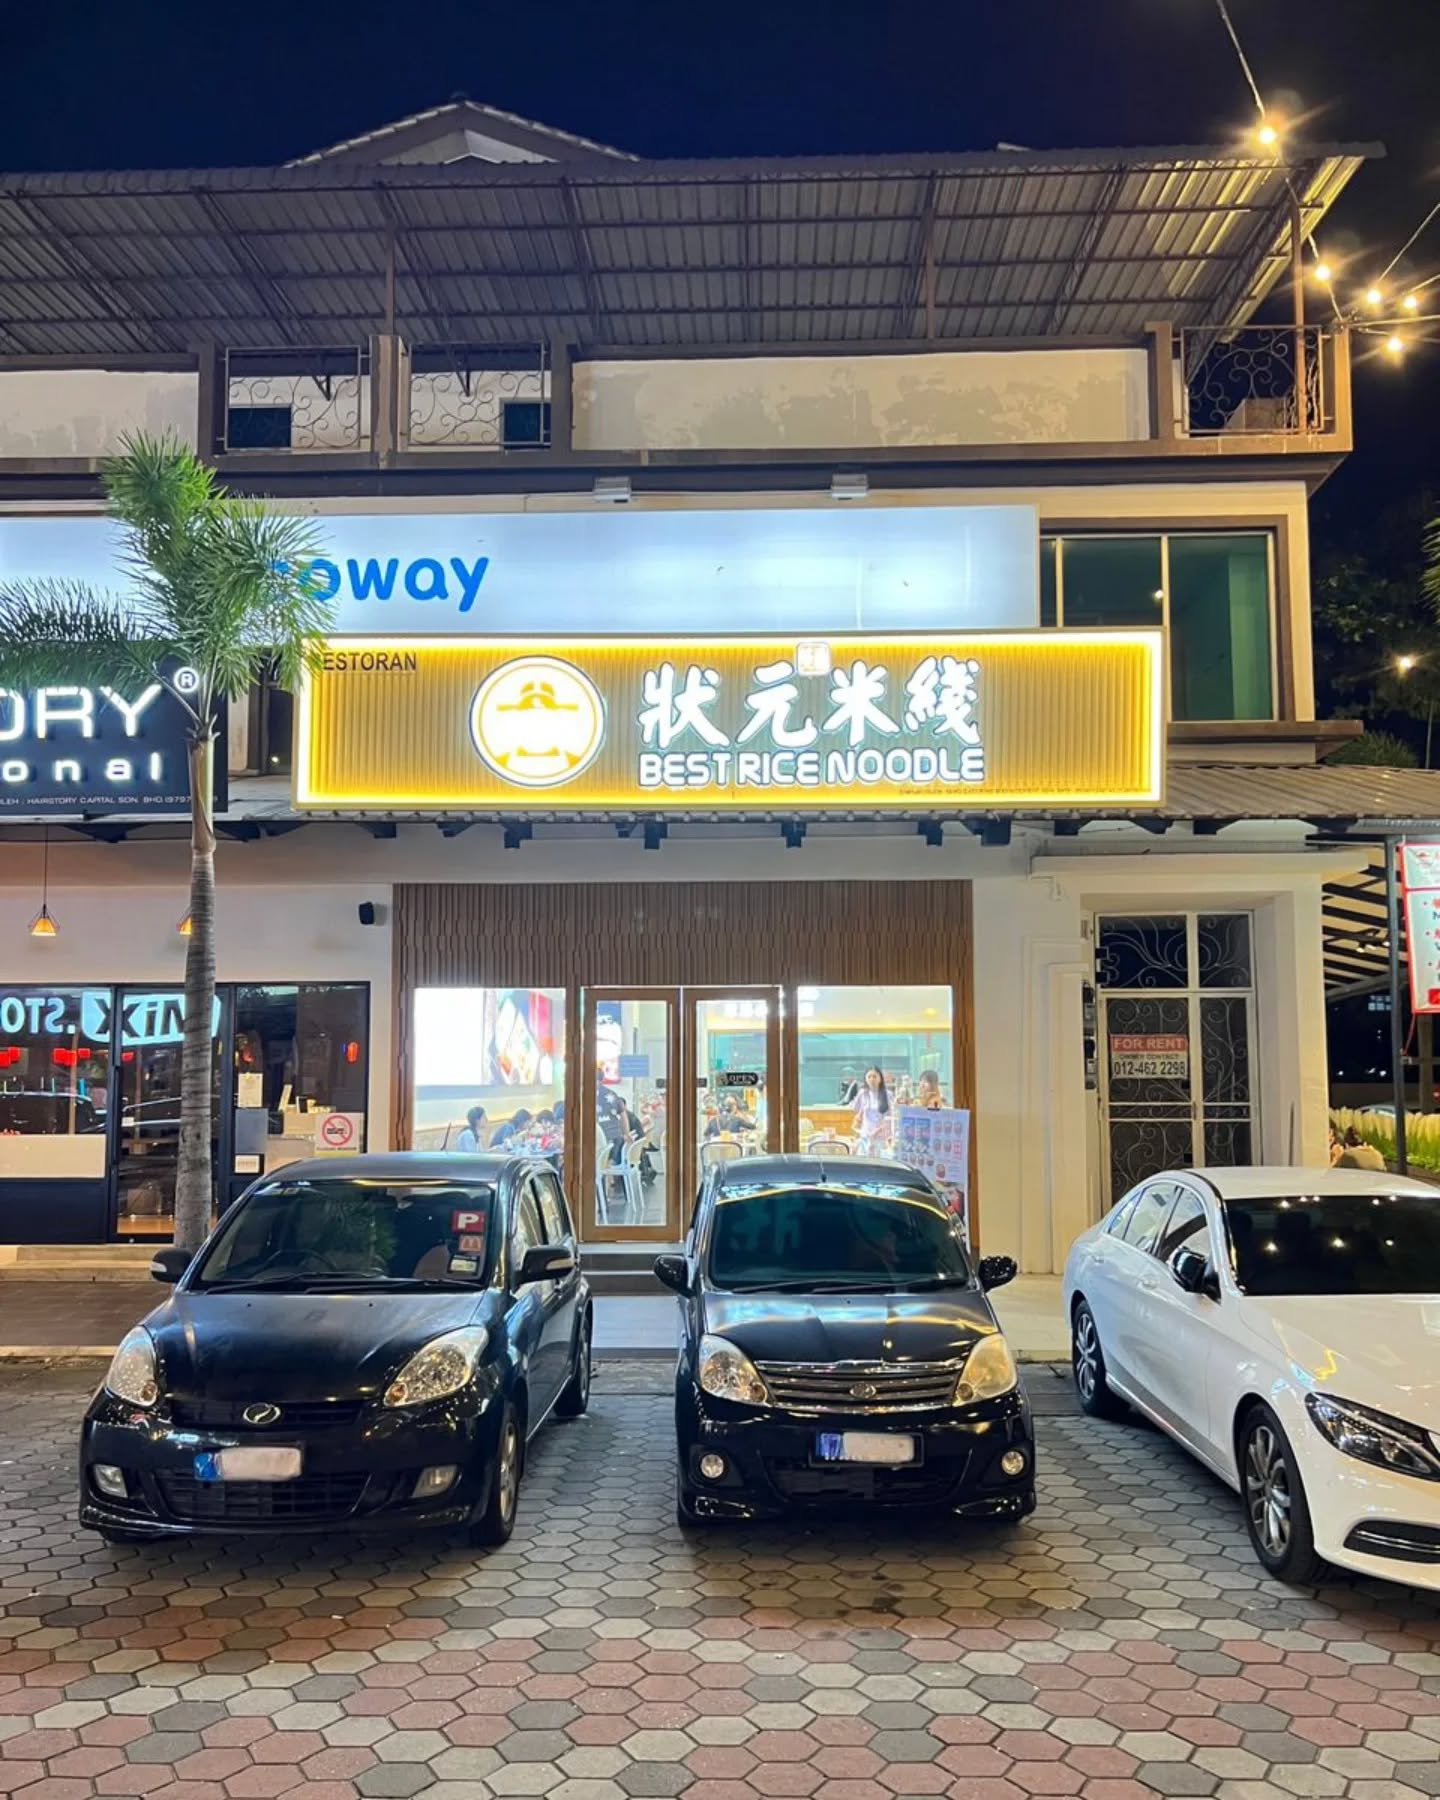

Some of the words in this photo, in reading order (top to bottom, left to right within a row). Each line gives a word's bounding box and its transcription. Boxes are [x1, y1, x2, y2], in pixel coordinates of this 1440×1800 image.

[264, 557, 489, 612] oway
[312, 652, 417, 671] ESTORAN
[2, 752, 162, 782] onal
[638, 752, 731, 786] BEST
[737, 752, 821, 786] RICE
[825, 747, 985, 784] NOODLE
[1114, 1038, 1142, 1049] FOR
[1147, 1037, 1184, 1049] RENT
[1114, 1061, 1157, 1076] 012-462
[458, 1213, 480, 1229] P
